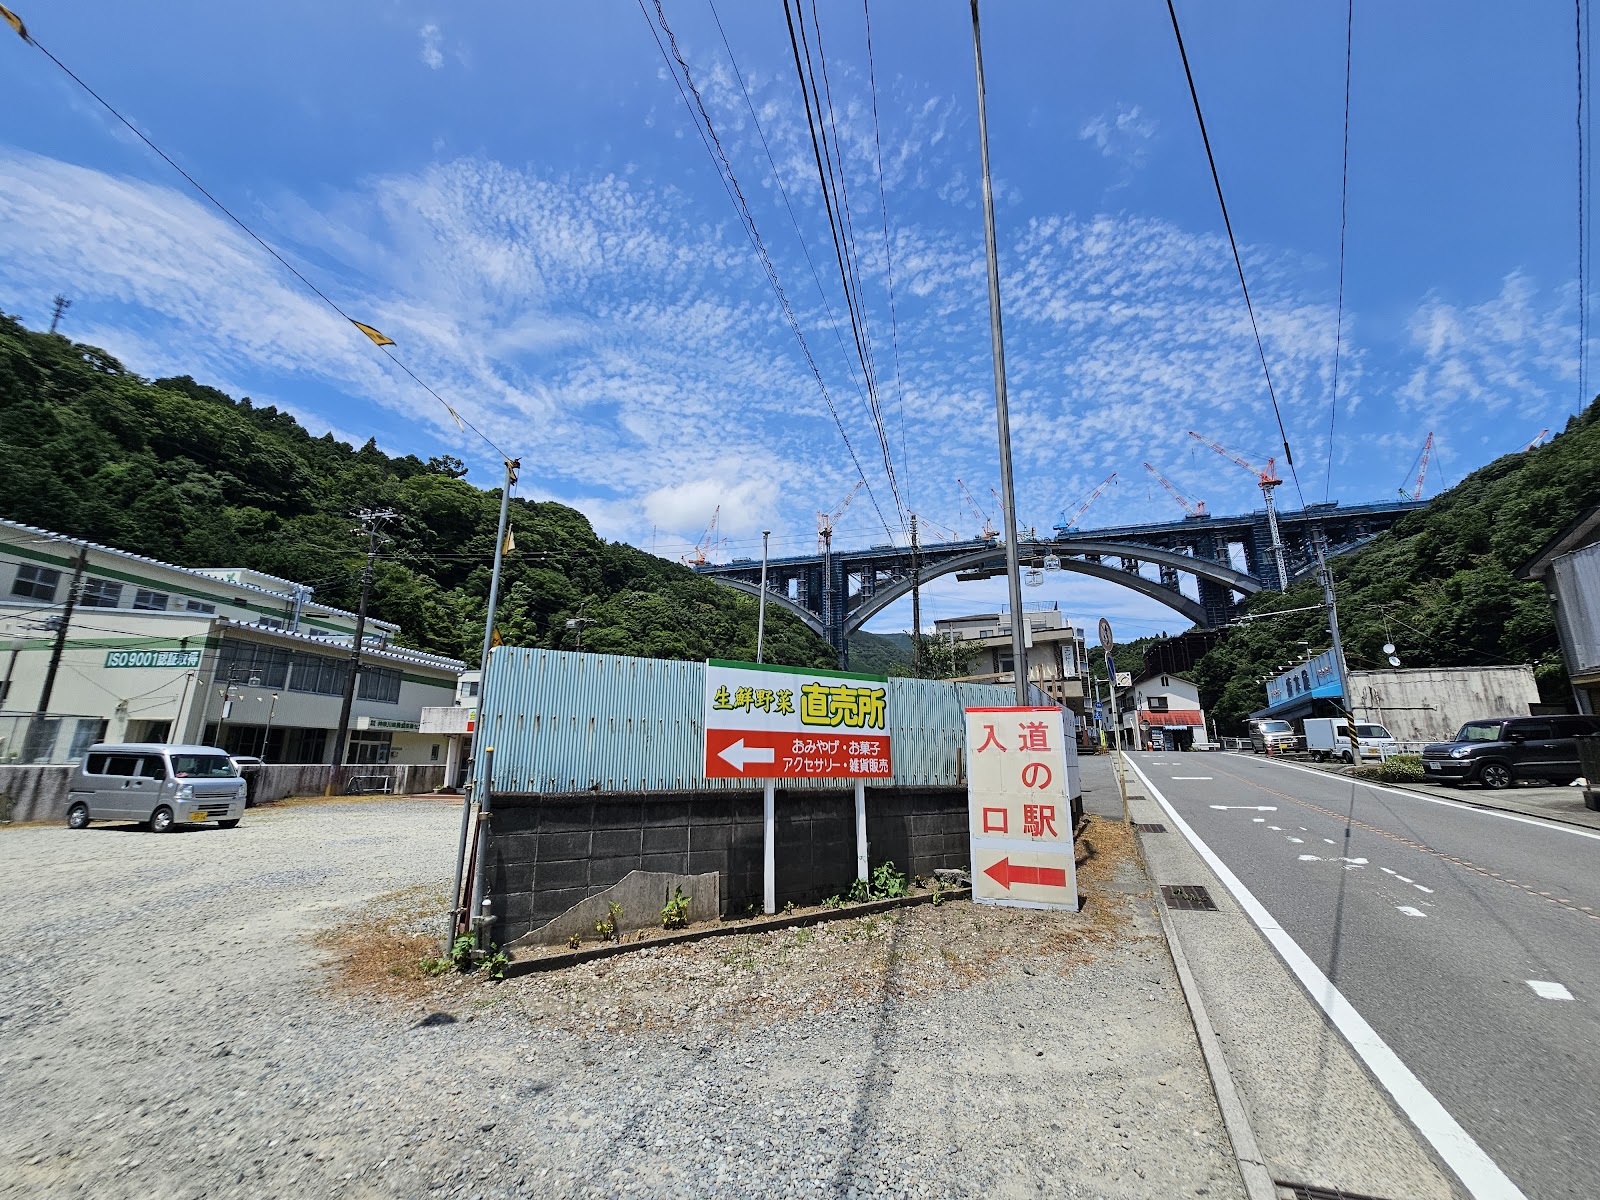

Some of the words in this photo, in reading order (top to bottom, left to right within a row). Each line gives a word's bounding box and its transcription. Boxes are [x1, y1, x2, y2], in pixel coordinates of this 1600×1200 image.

[713, 685, 795, 716] 生鮮野菜
[801, 682, 886, 730] 直売所
[783, 757, 888, 773] アクセサリー・雑貨販売
[792, 738, 881, 756] おみやげ・お菓子
[977, 725, 1008, 833] 入口
[1018, 721, 1058, 837] 道の駅
